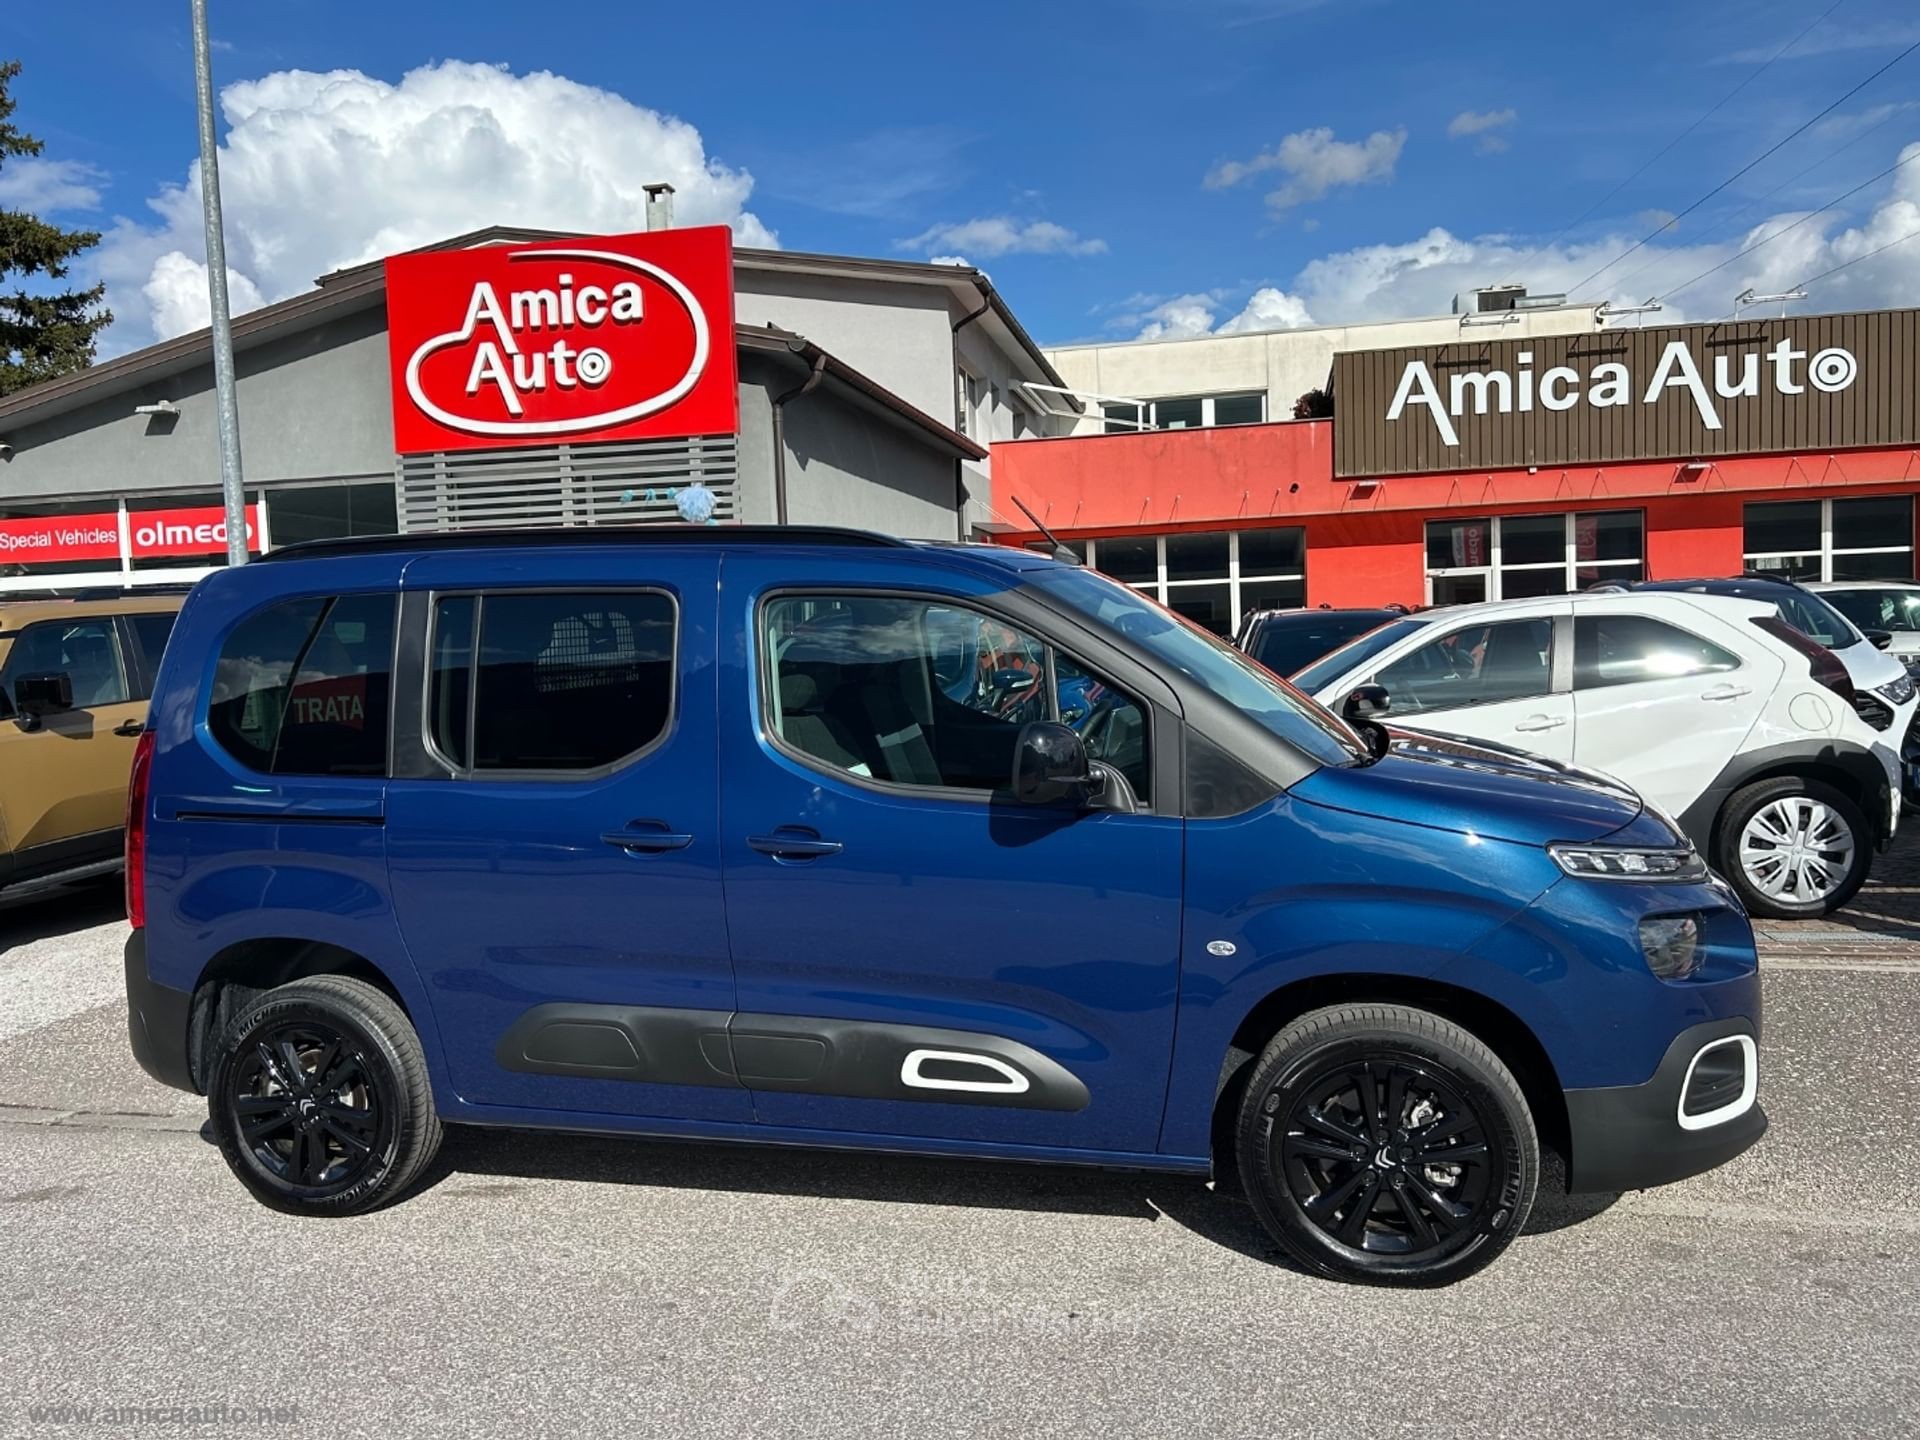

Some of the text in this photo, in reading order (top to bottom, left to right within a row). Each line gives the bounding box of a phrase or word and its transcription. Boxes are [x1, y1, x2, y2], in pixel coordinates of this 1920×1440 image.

[461, 273, 644, 355] Amica
[465, 339, 612, 415] Auto
[1385, 337, 1858, 447] Amica Auto
[0, 527, 117, 552] Special Vehicles
[293, 695, 365, 724] TRATA
